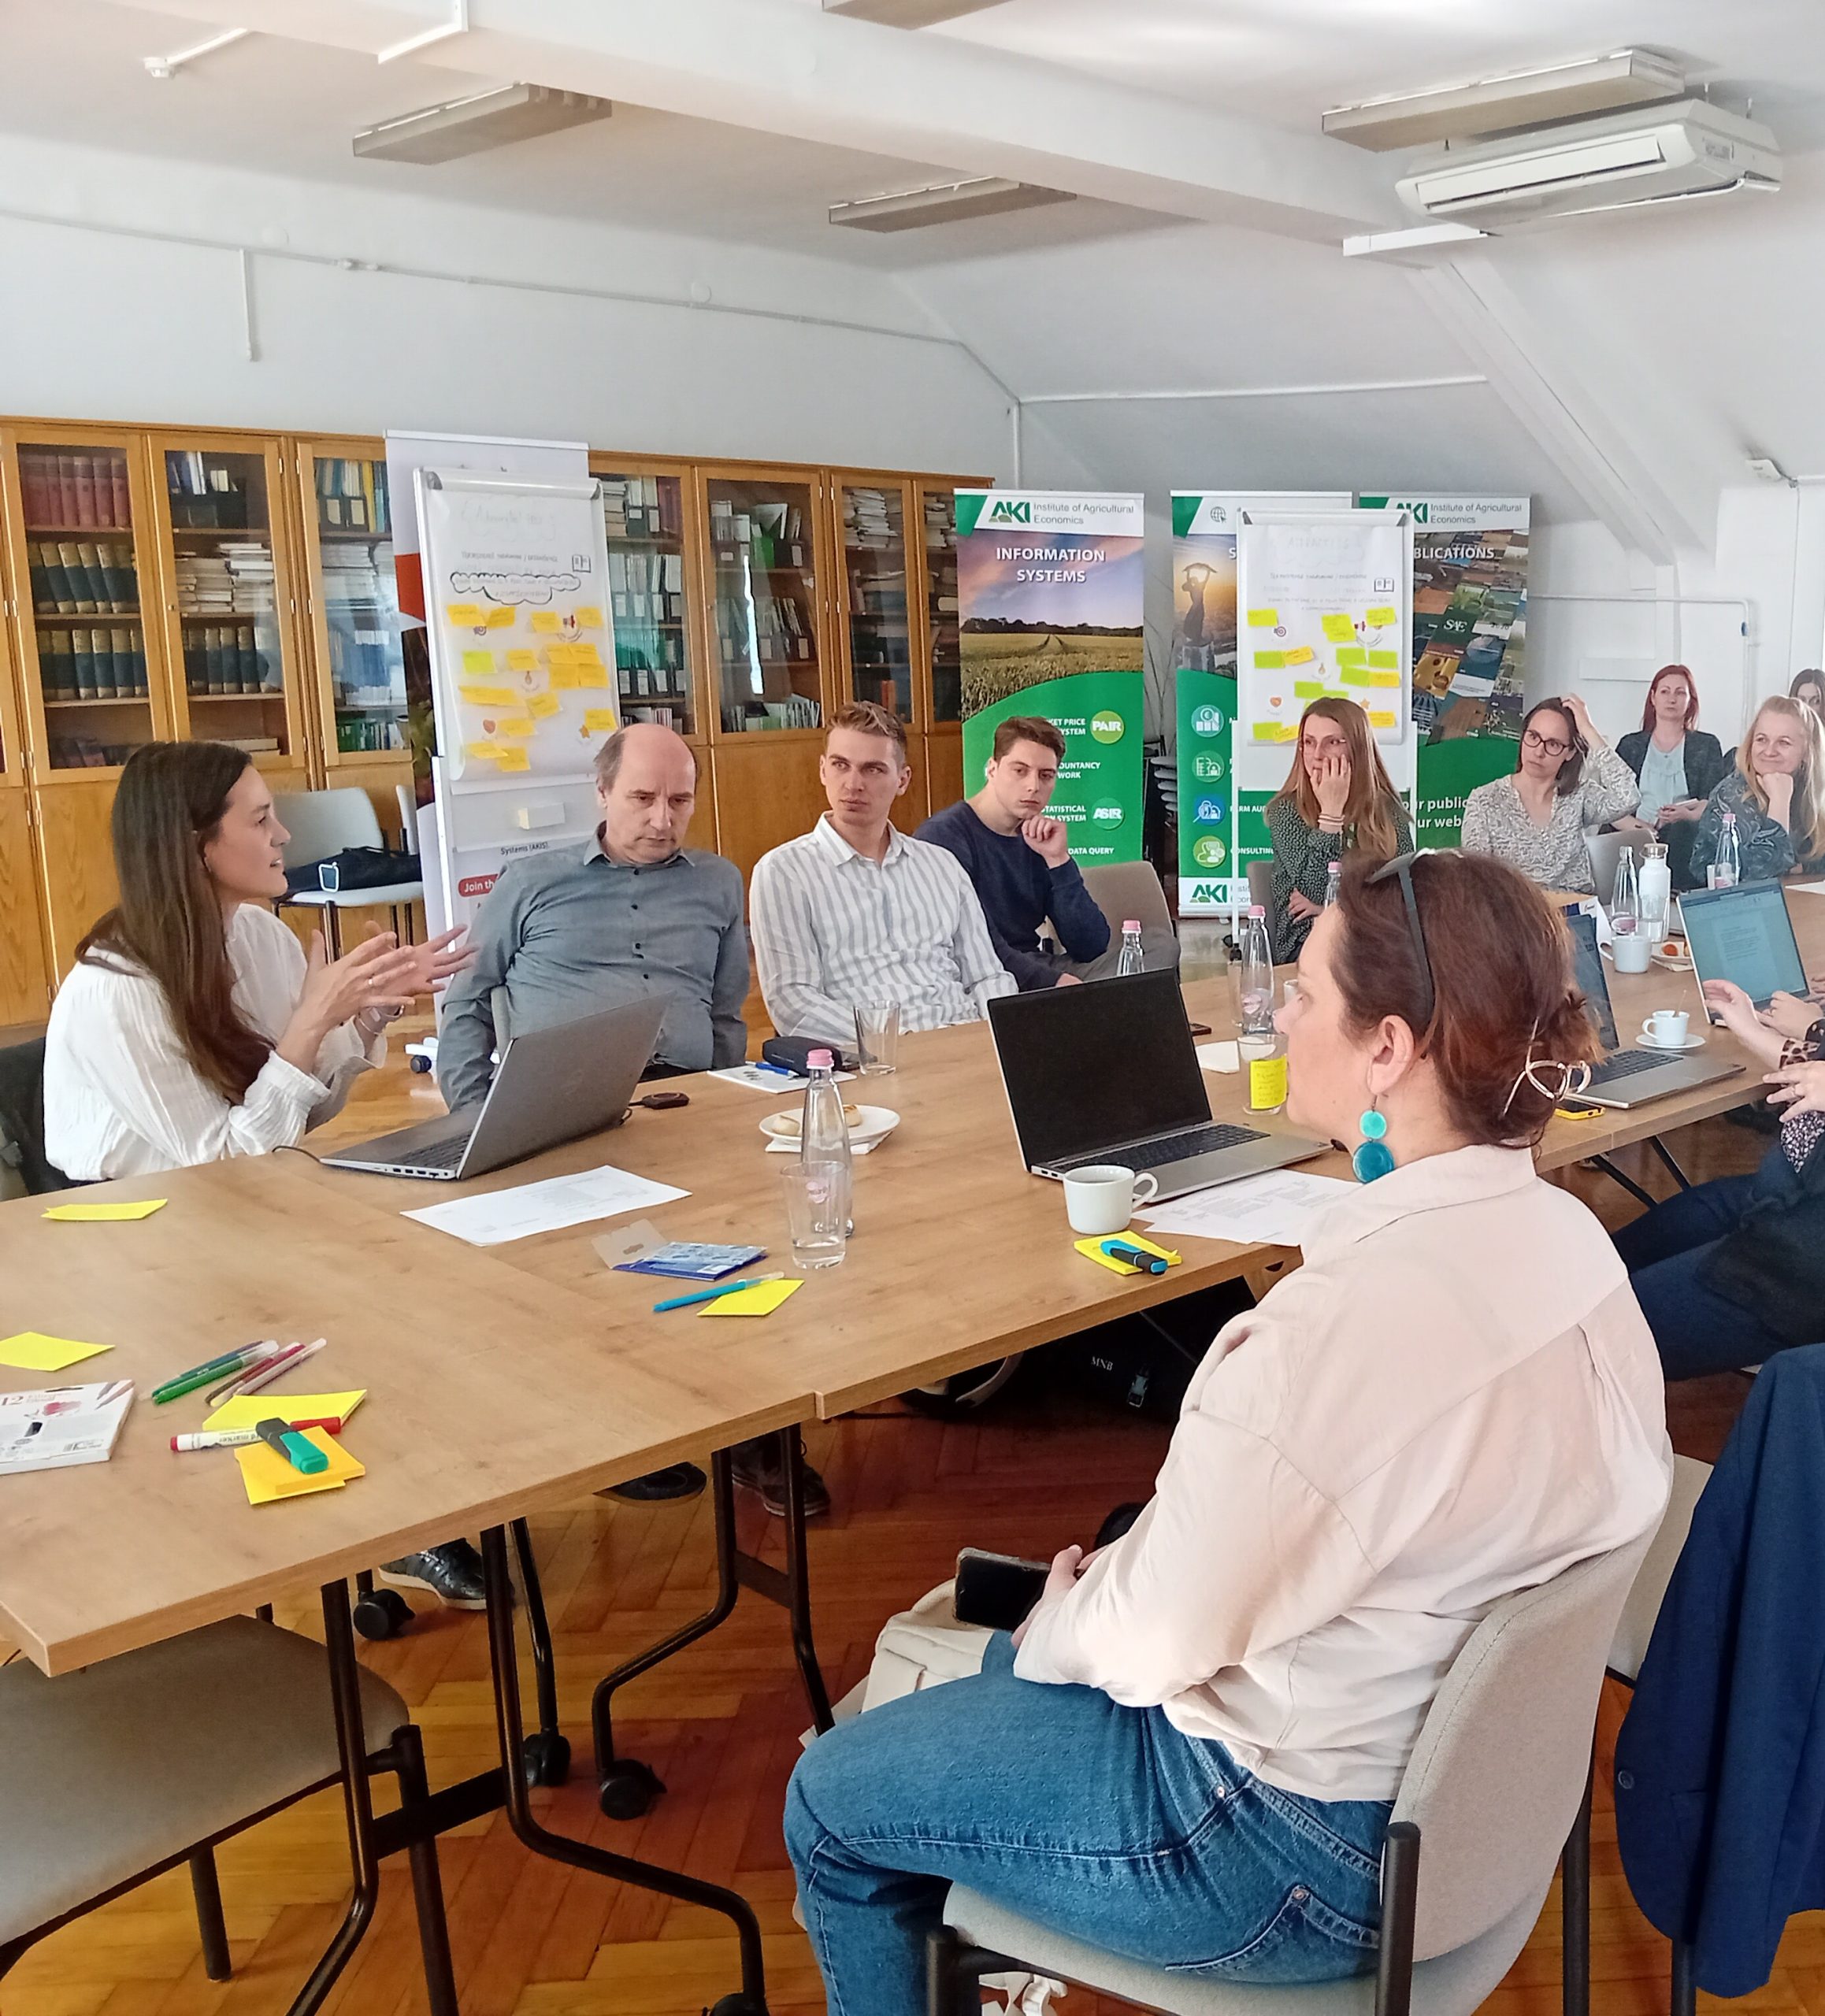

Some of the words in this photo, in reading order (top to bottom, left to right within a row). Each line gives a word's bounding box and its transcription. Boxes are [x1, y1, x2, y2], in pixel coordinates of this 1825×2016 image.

[989, 501, 1030, 523] AKI
[1033, 502, 1070, 512] Institute
[1072, 503, 1081, 512] of
[1083, 504, 1134, 514] Agricultural
[1430, 503, 1463, 513] Institute
[1465, 503, 1474, 512] of
[1475, 503, 1523, 513] Agricultural
[1033, 514, 1085, 524] Economics
[1430, 515, 1476, 524] Economics
[996, 547, 1106, 562] INFORMATION
[1414, 547, 1495, 560] BLICATIONS
[1017, 569, 1086, 583] SYSTEMS
[1444, 618, 1467, 633] SAE
[1092, 721, 1122, 732] PAIR
[1427, 796, 1467, 813] public
[1417, 819, 1432, 828] ur
[1434, 814, 1462, 828] web
[500, 846, 529, 856] Systems
[1089, 847, 1115, 856] QUERY
[464, 881, 484, 893] Join
[1189, 884, 1228, 903] AKI
[1090, 1355, 1114, 1371] MNB
